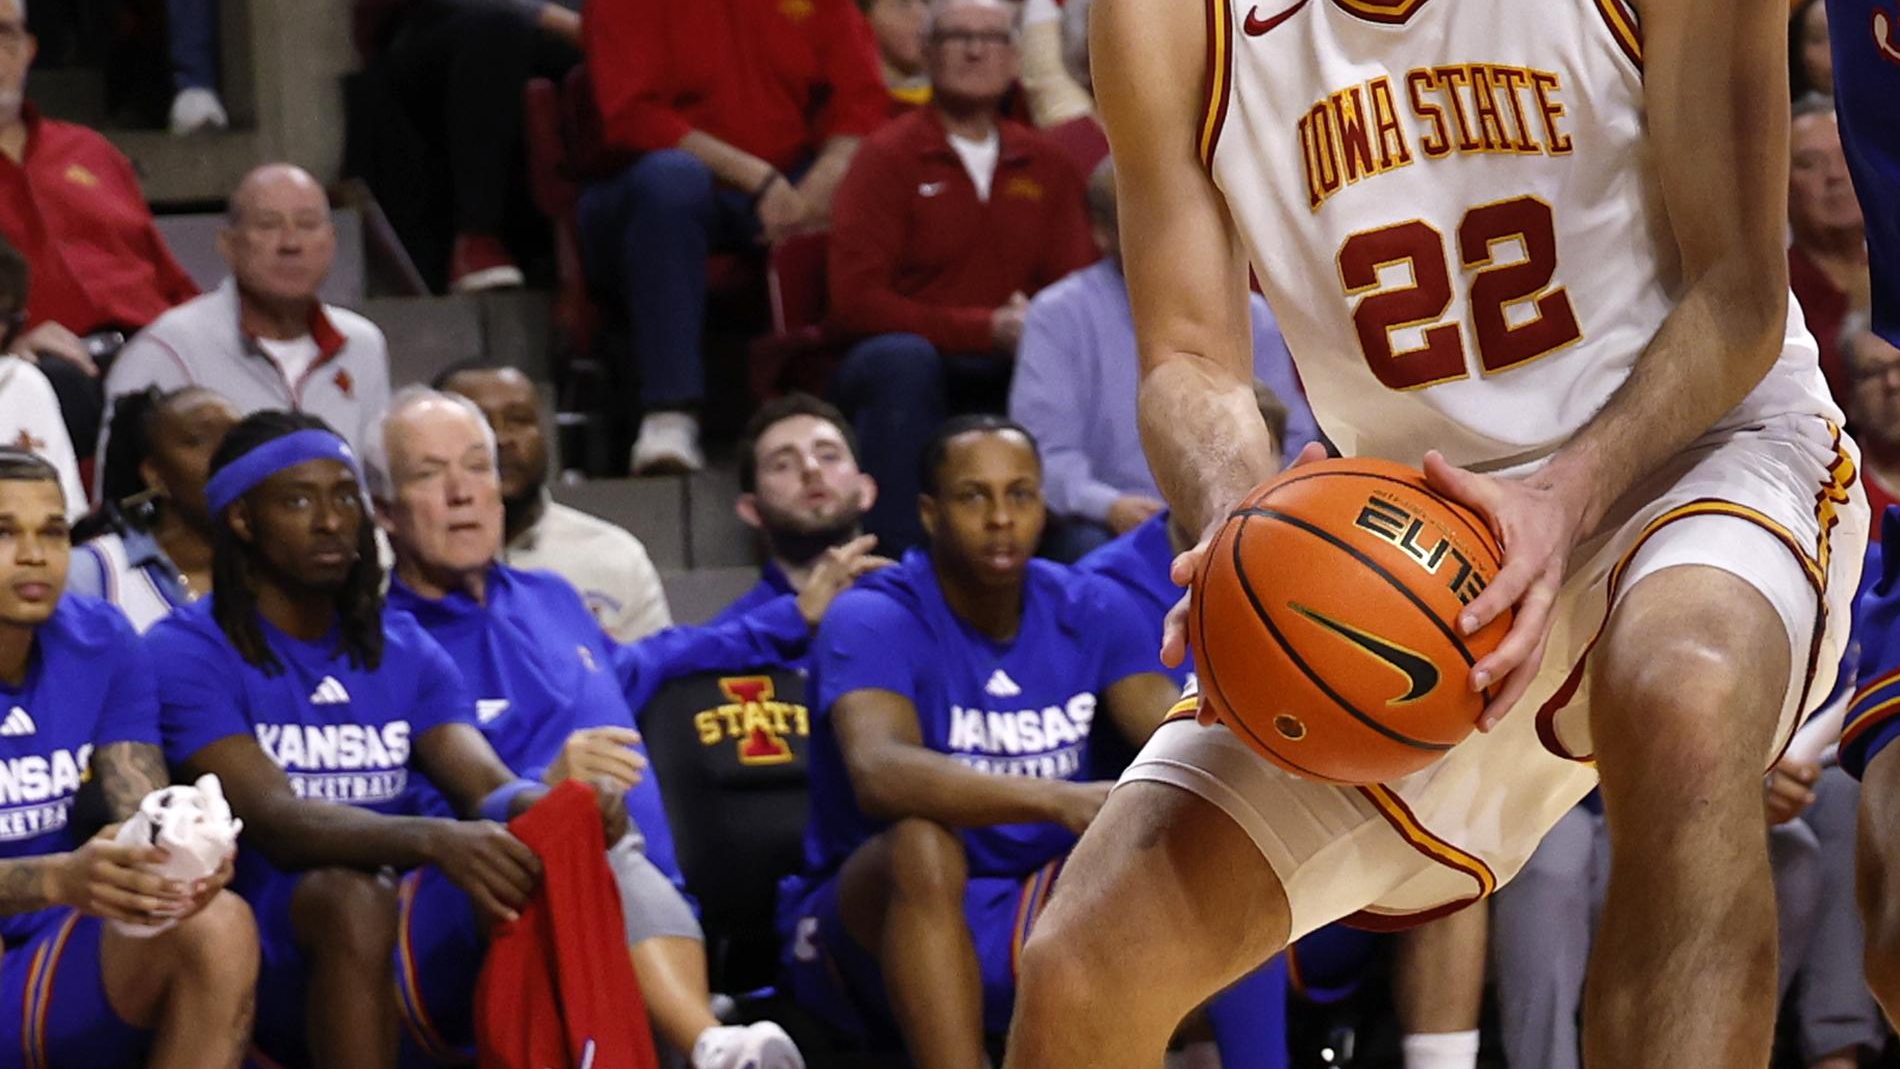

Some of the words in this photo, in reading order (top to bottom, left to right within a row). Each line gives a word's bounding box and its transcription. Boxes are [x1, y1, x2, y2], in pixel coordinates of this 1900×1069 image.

[1298, 74, 1413, 212] IOWA
[1406, 63, 1573, 158] STATE
[1336, 194, 1585, 392] 22
